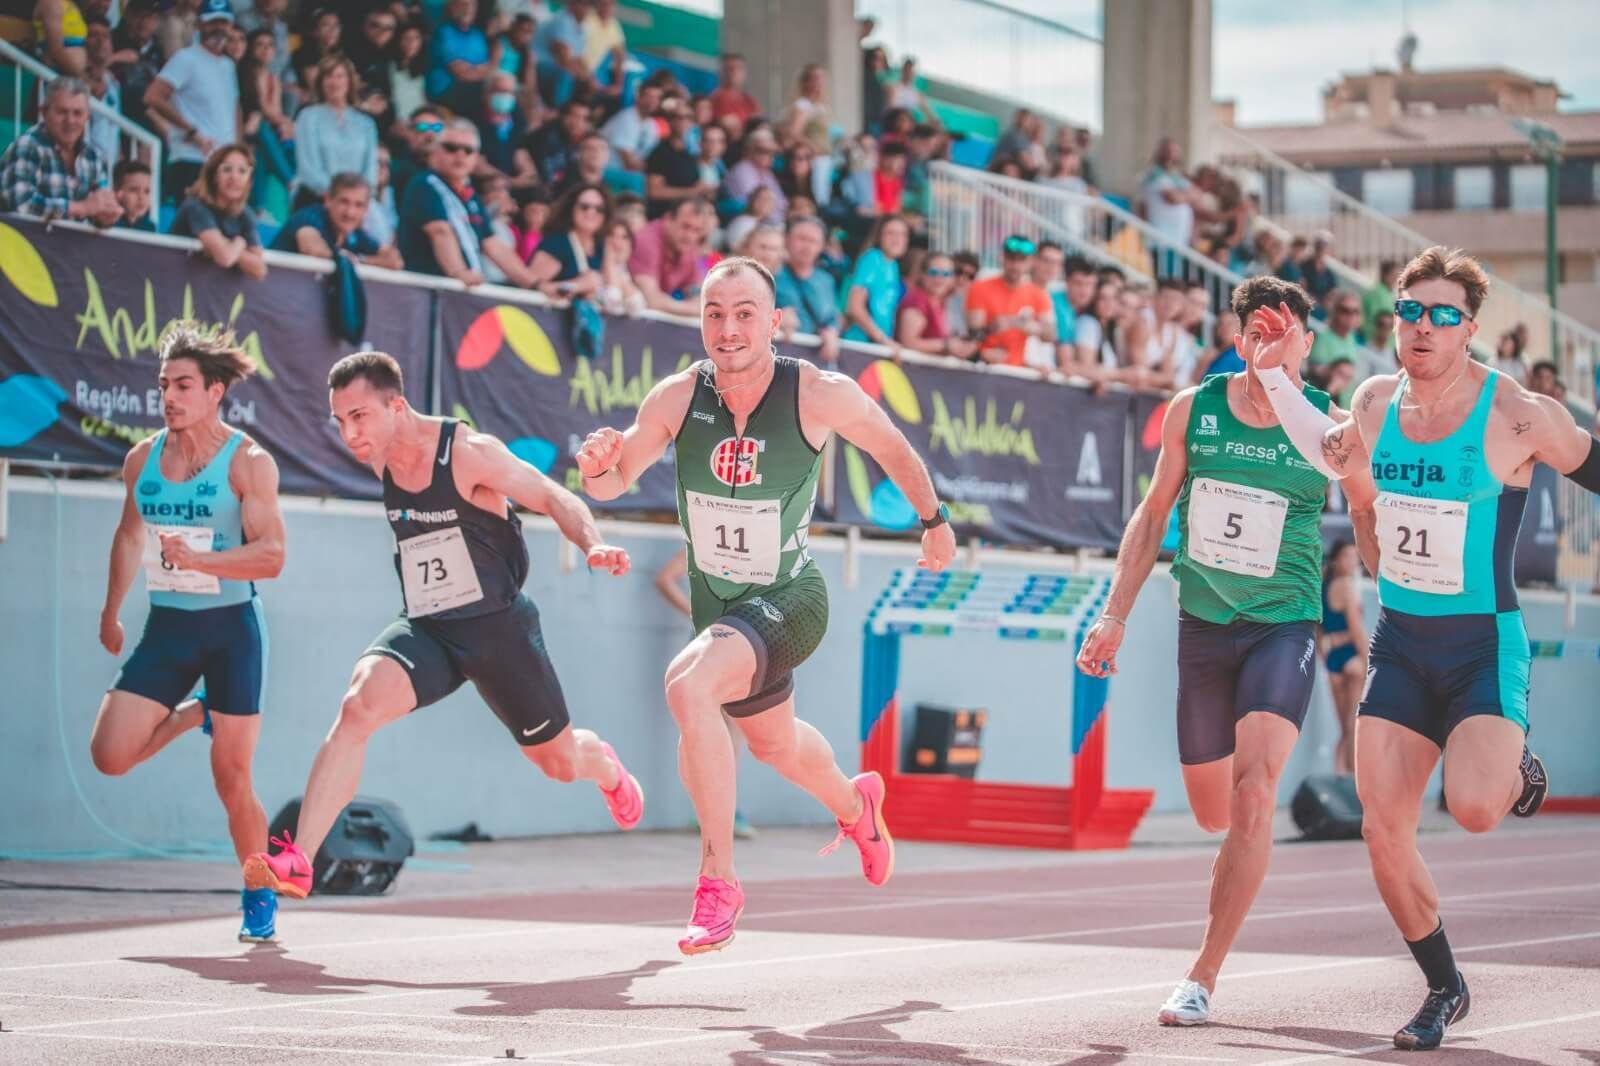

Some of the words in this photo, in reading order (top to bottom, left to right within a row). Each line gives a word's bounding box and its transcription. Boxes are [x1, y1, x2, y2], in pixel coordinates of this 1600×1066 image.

[76, 380, 142, 419] Región
[1372, 457, 1446, 487] nerja
[141, 499, 213, 520] nerja
[715, 524, 750, 554] 11
[1223, 512, 1243, 539] 5
[1396, 525, 1431, 558] 21
[417, 557, 448, 585] 73
